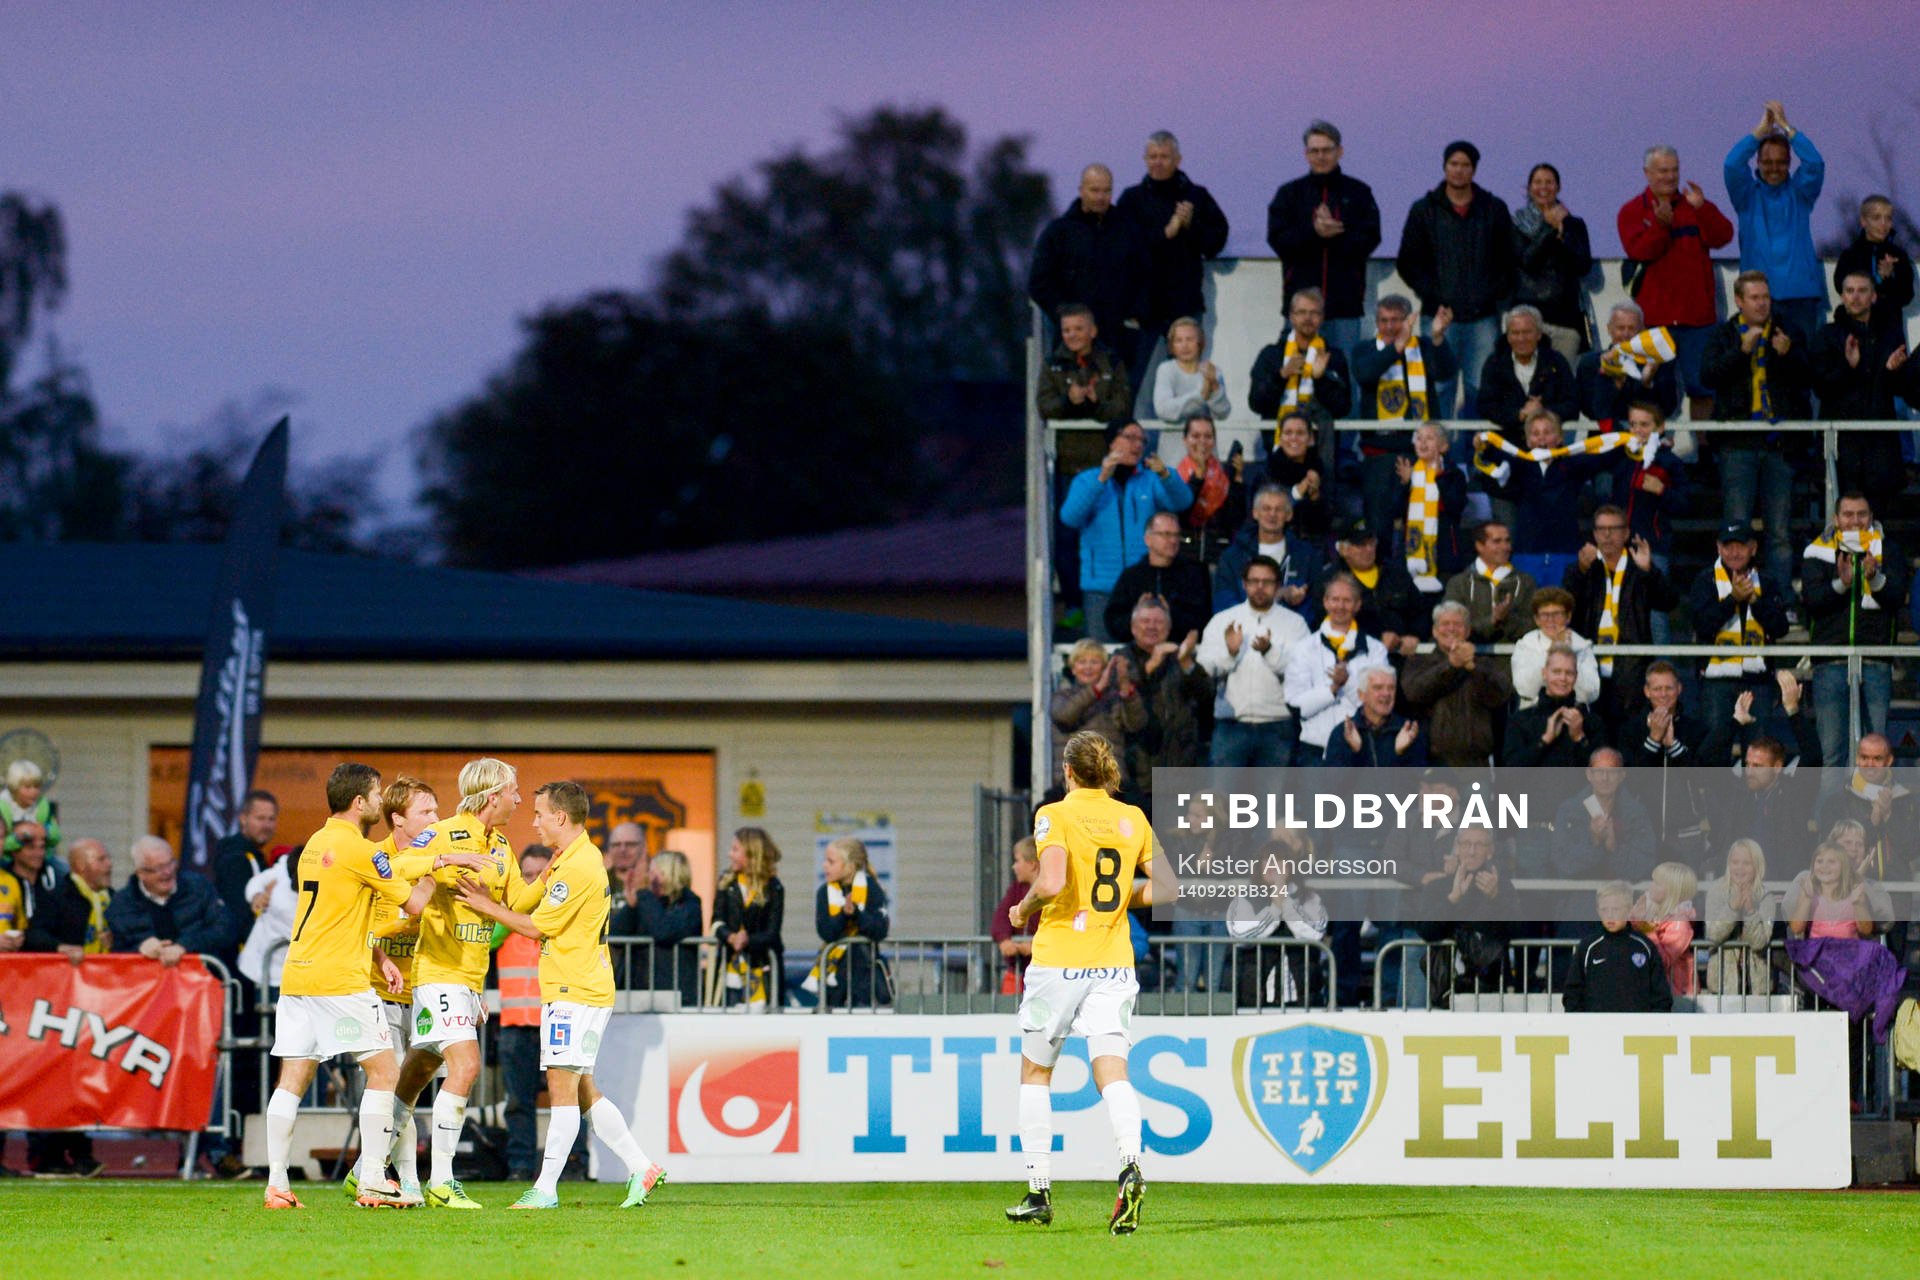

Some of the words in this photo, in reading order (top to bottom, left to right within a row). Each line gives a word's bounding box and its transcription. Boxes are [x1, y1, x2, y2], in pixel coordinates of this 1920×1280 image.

[294, 880, 319, 942] 7
[1090, 847, 1122, 913] 8
[439, 994, 449, 1012] 5
[28, 998, 172, 1088] HYR
[1262, 1051, 1358, 1078] TIPS
[828, 1035, 1212, 1157] TIPS
[1403, 1034, 1797, 1159] ELIT
[1262, 1079, 1358, 1106] ELIT
